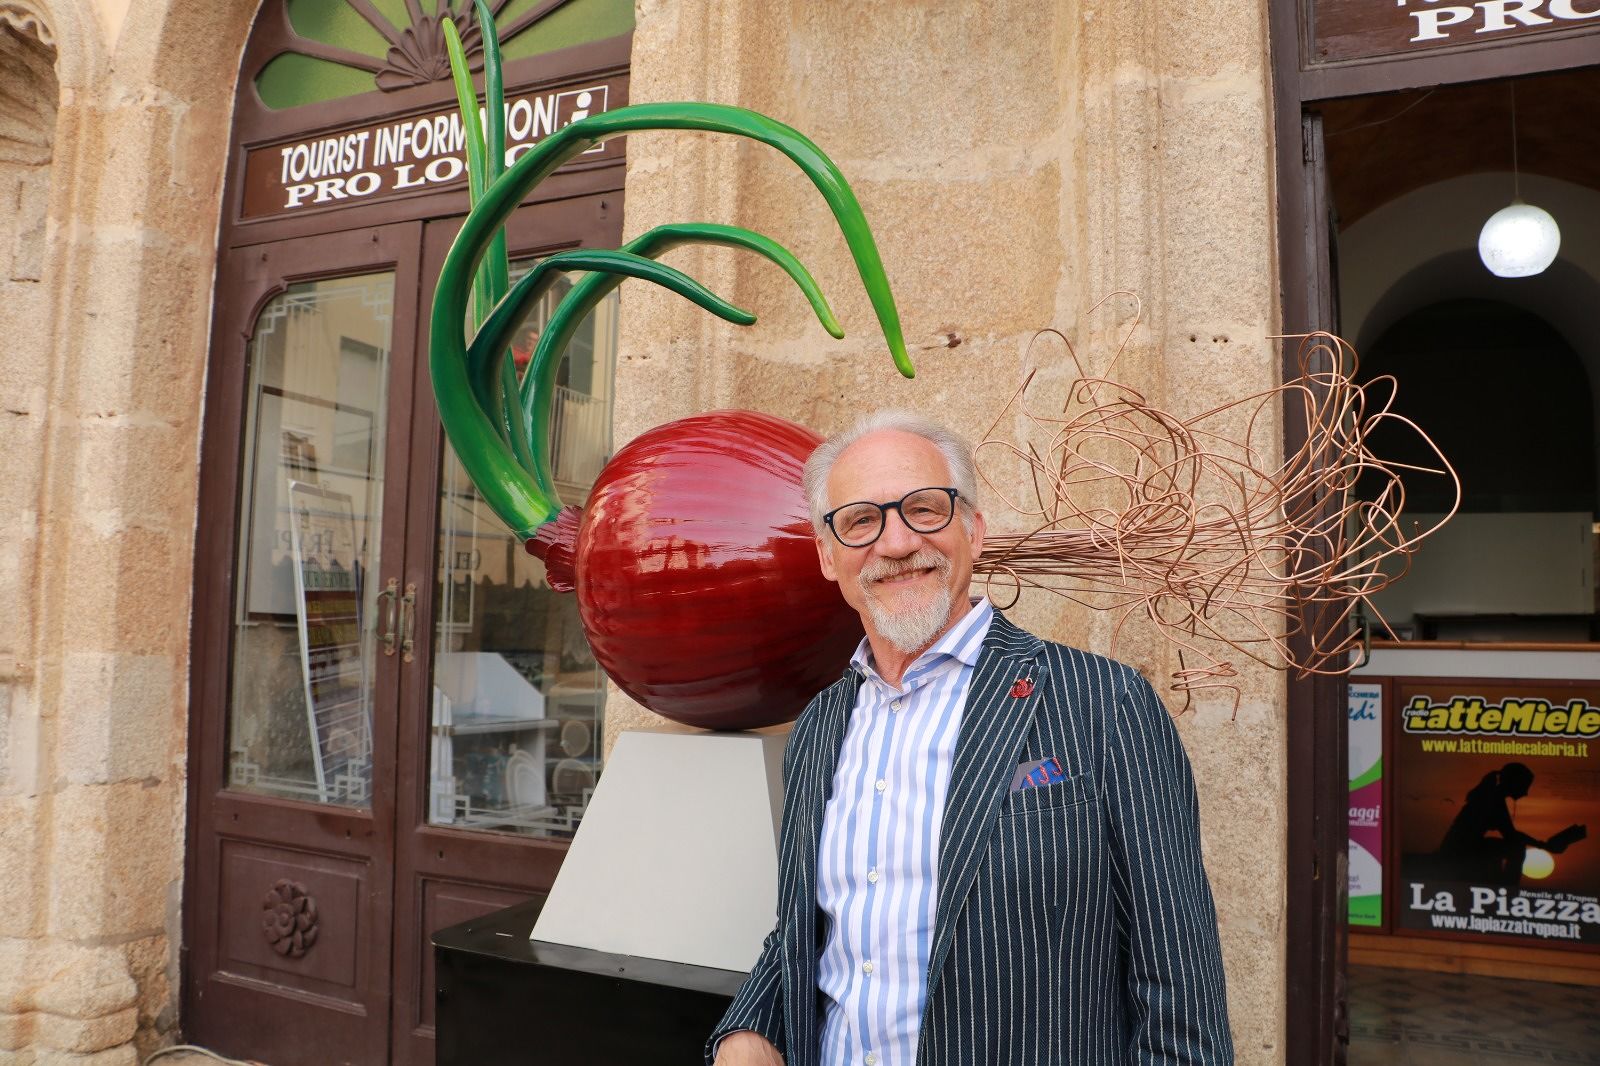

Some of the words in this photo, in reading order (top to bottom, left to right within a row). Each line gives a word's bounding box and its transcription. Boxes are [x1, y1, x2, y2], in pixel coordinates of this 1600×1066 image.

[281, 131, 369, 184] TOURIST
[284, 172, 381, 209] PRO
[1409, 699, 1600, 733] LatteMiele
[1422, 739, 1589, 758] www.lattemielecalabria.it
[1410, 882, 1456, 912] La
[1470, 886, 1600, 924] Piazza
[1520, 889, 1553, 900] Mensile
[1554, 892, 1564, 900] di
[1431, 914, 1582, 940] www.lapiazzatropea.it
